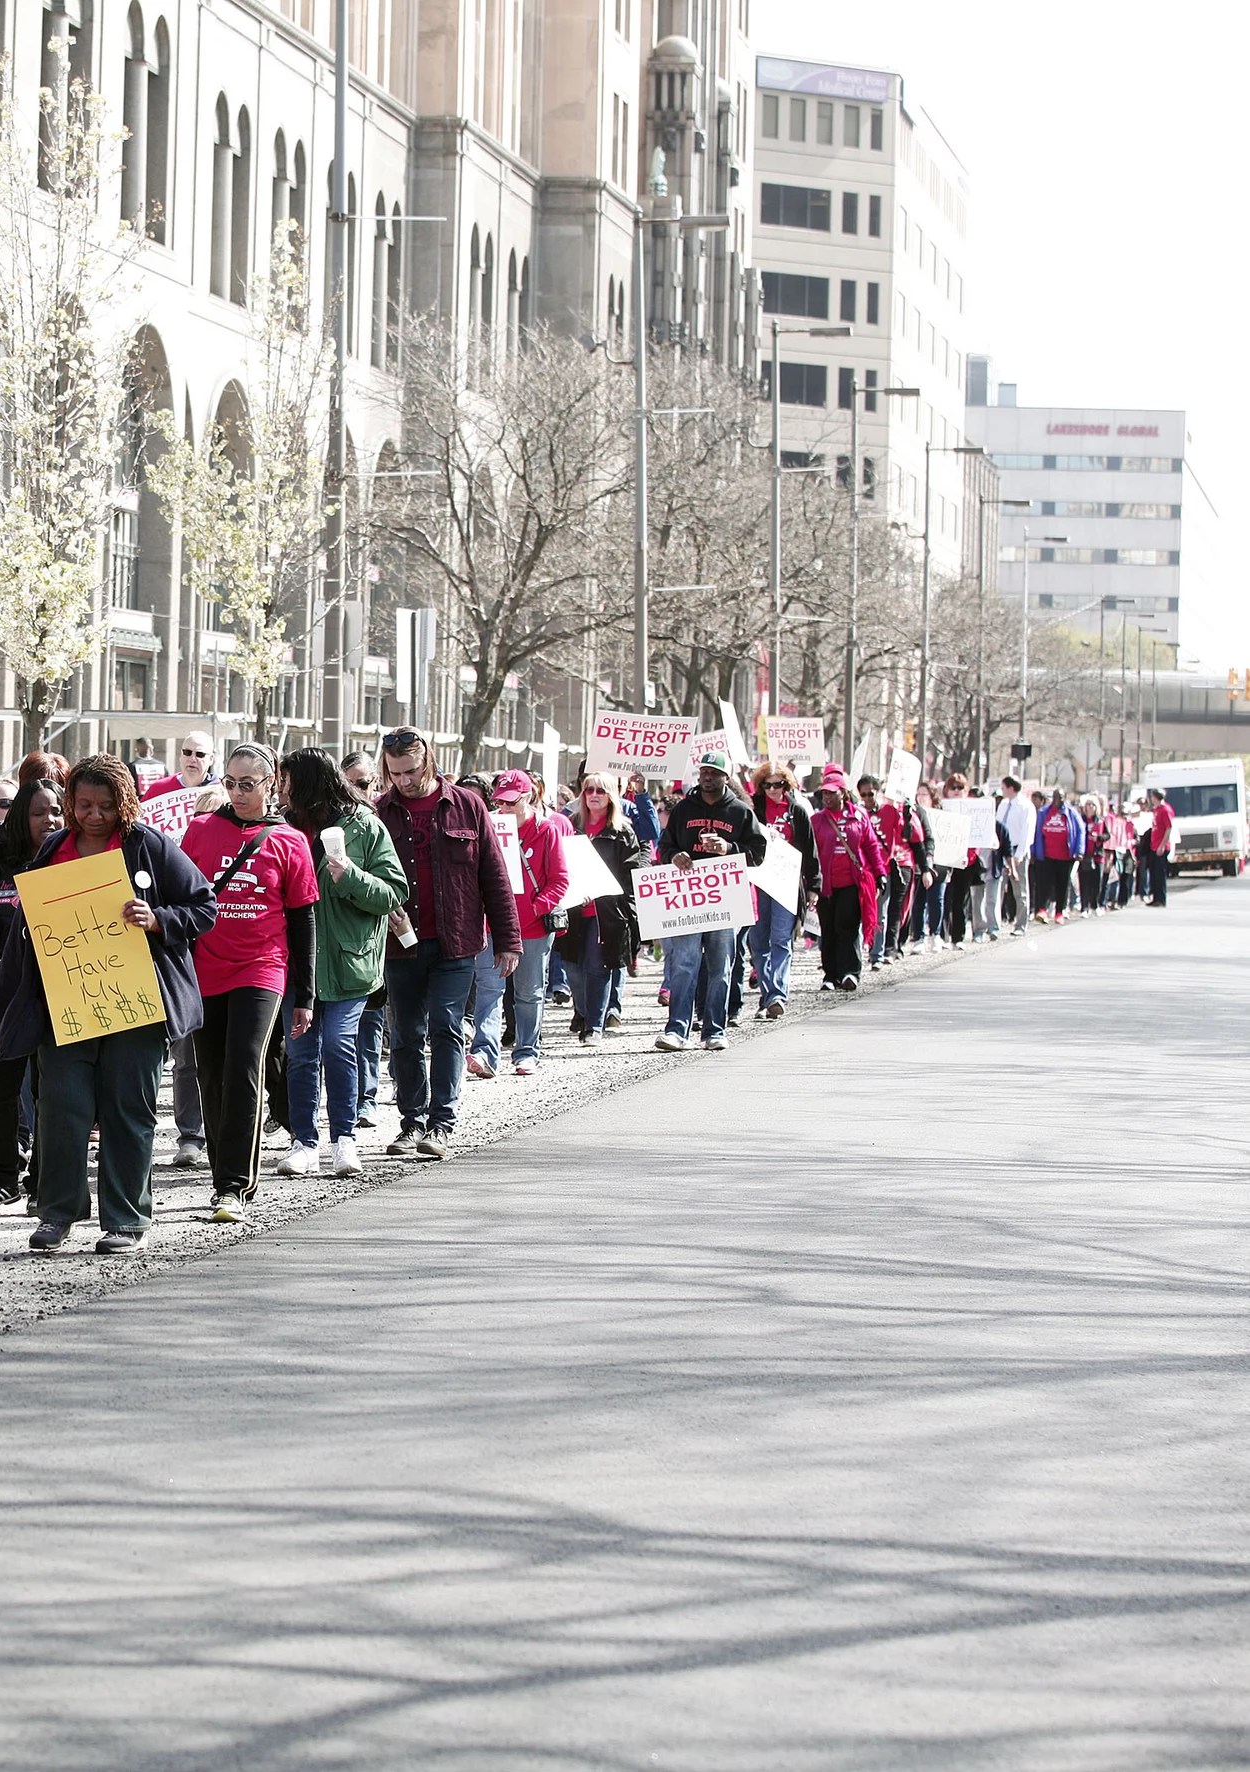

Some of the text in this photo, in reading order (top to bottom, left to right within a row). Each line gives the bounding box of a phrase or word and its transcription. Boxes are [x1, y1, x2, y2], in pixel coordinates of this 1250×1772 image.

[603, 717, 628, 727] OUR
[632, 720, 665, 730] FIGHT
[596, 725, 691, 744] DETROIT
[768, 729, 820, 739] DETROIT
[616, 742, 667, 757] KIDS
[778, 740, 806, 749] KIDS
[167, 792, 198, 805] FIGH
[221, 855, 256, 870] DT
[641, 861, 738, 882] OUR FIGHT FOR
[638, 870, 744, 898] DETROIT
[226, 903, 268, 911] FEDERATION
[664, 889, 722, 911] KIDS
[220, 911, 257, 919] TEACHERS
[662, 911, 731, 929] www.ForDetroitKids.org
[62, 953, 125, 985] Have
